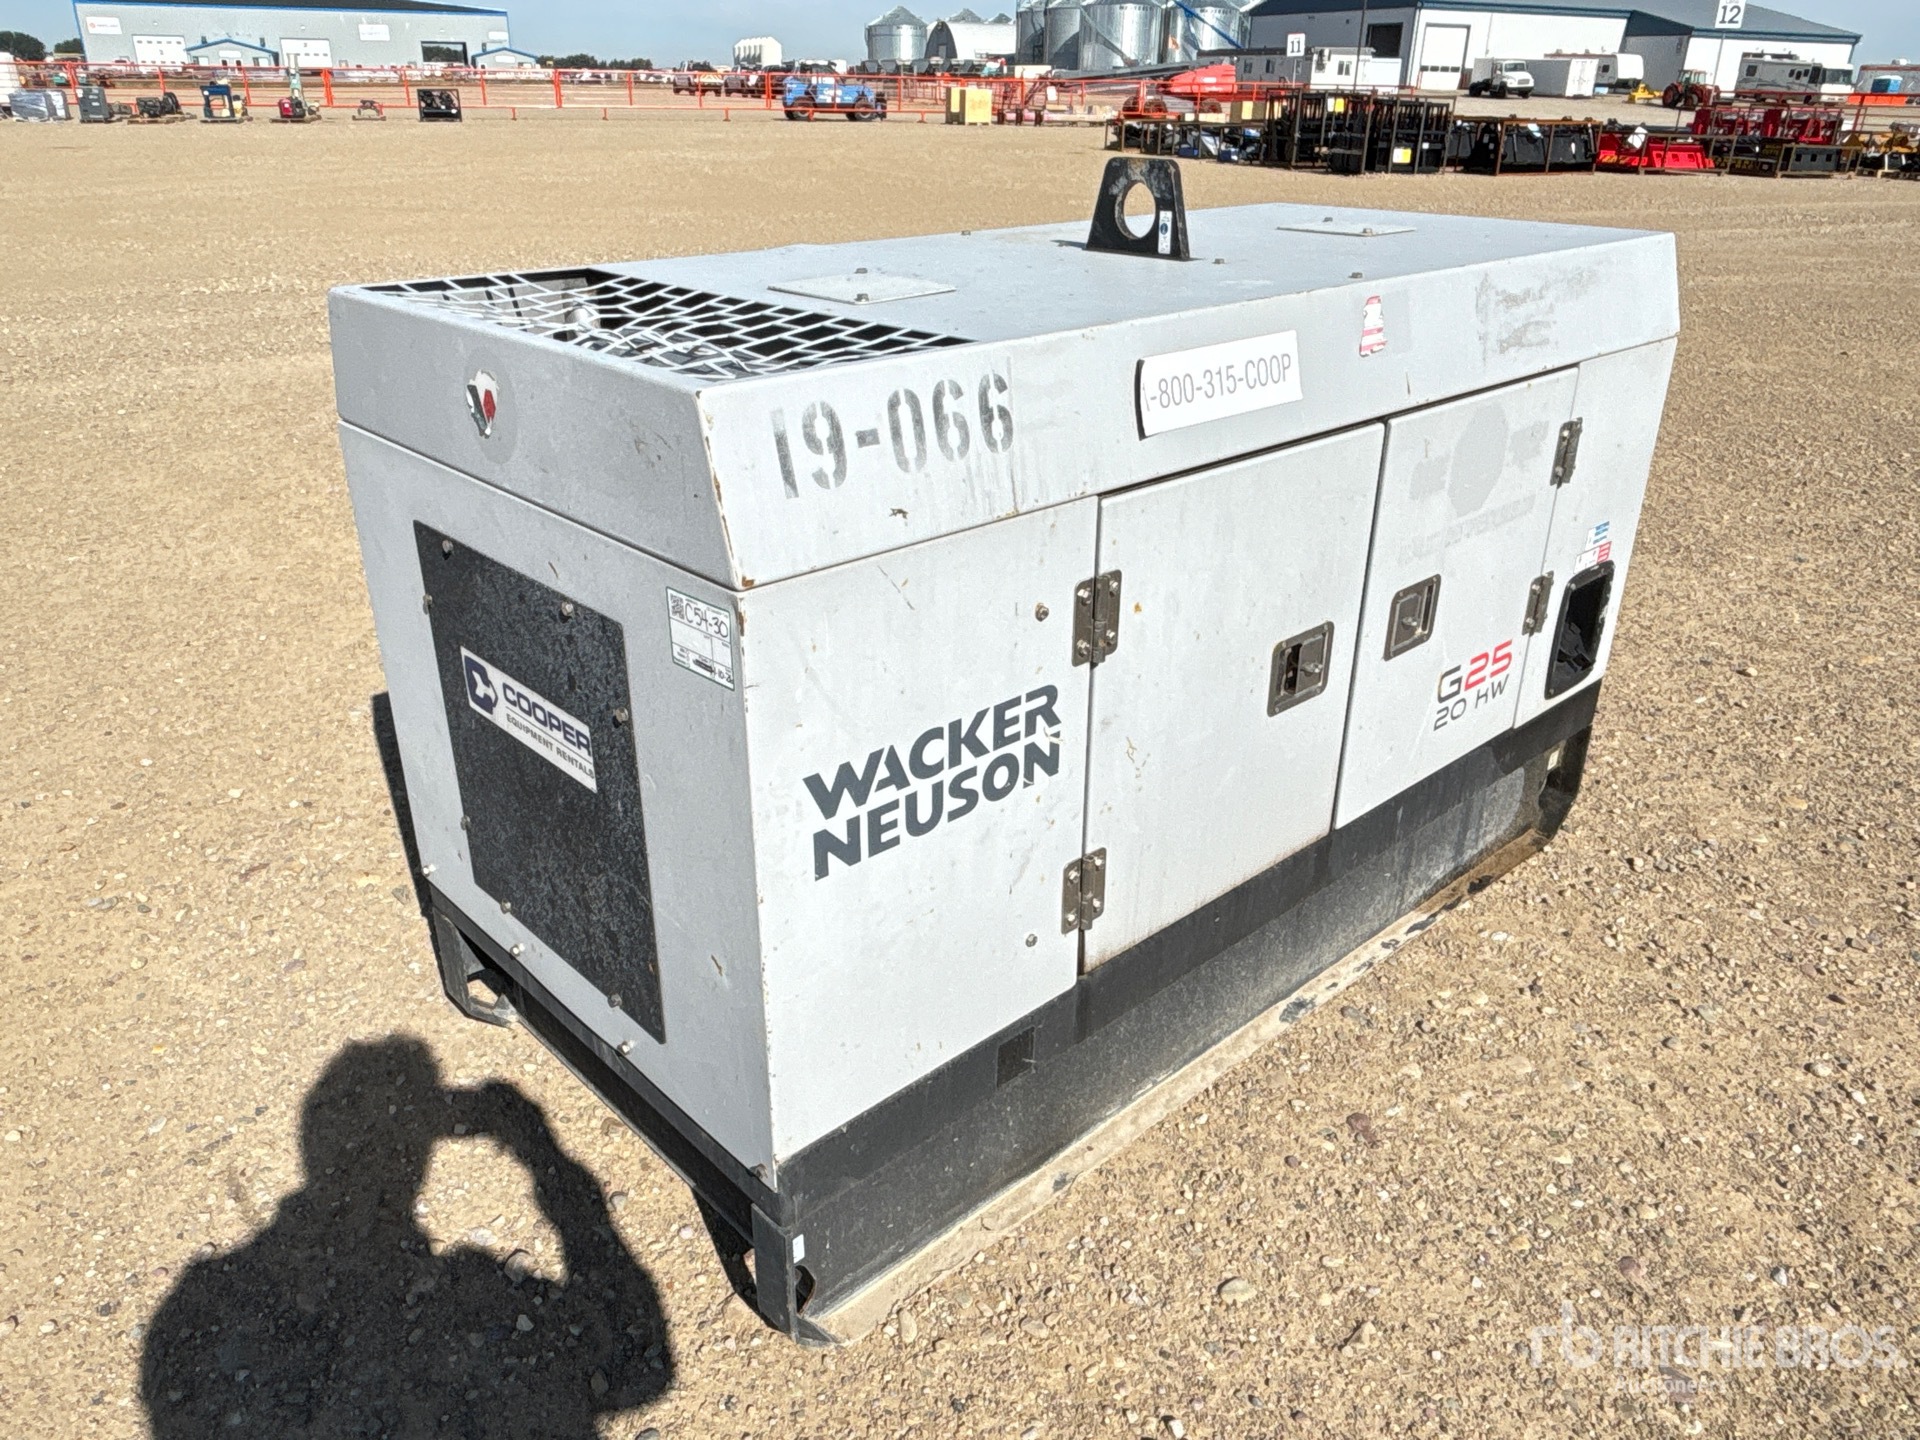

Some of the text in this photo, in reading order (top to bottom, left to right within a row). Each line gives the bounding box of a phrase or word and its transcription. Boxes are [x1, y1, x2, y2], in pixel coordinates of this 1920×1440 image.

[1290, 40, 1302, 53] 11
[1719, 5, 1742, 24] 12
[769, 373, 1015, 500] 19-066
[1433, 674, 1510, 732] 20 HW
[1438, 639, 1513, 704] G25
[502, 683, 593, 758] COOPER
[506, 713, 595, 780] EQUIPMENT RENTALS
[802, 684, 1061, 820] WACKER
[813, 730, 1061, 882] NEUSON
